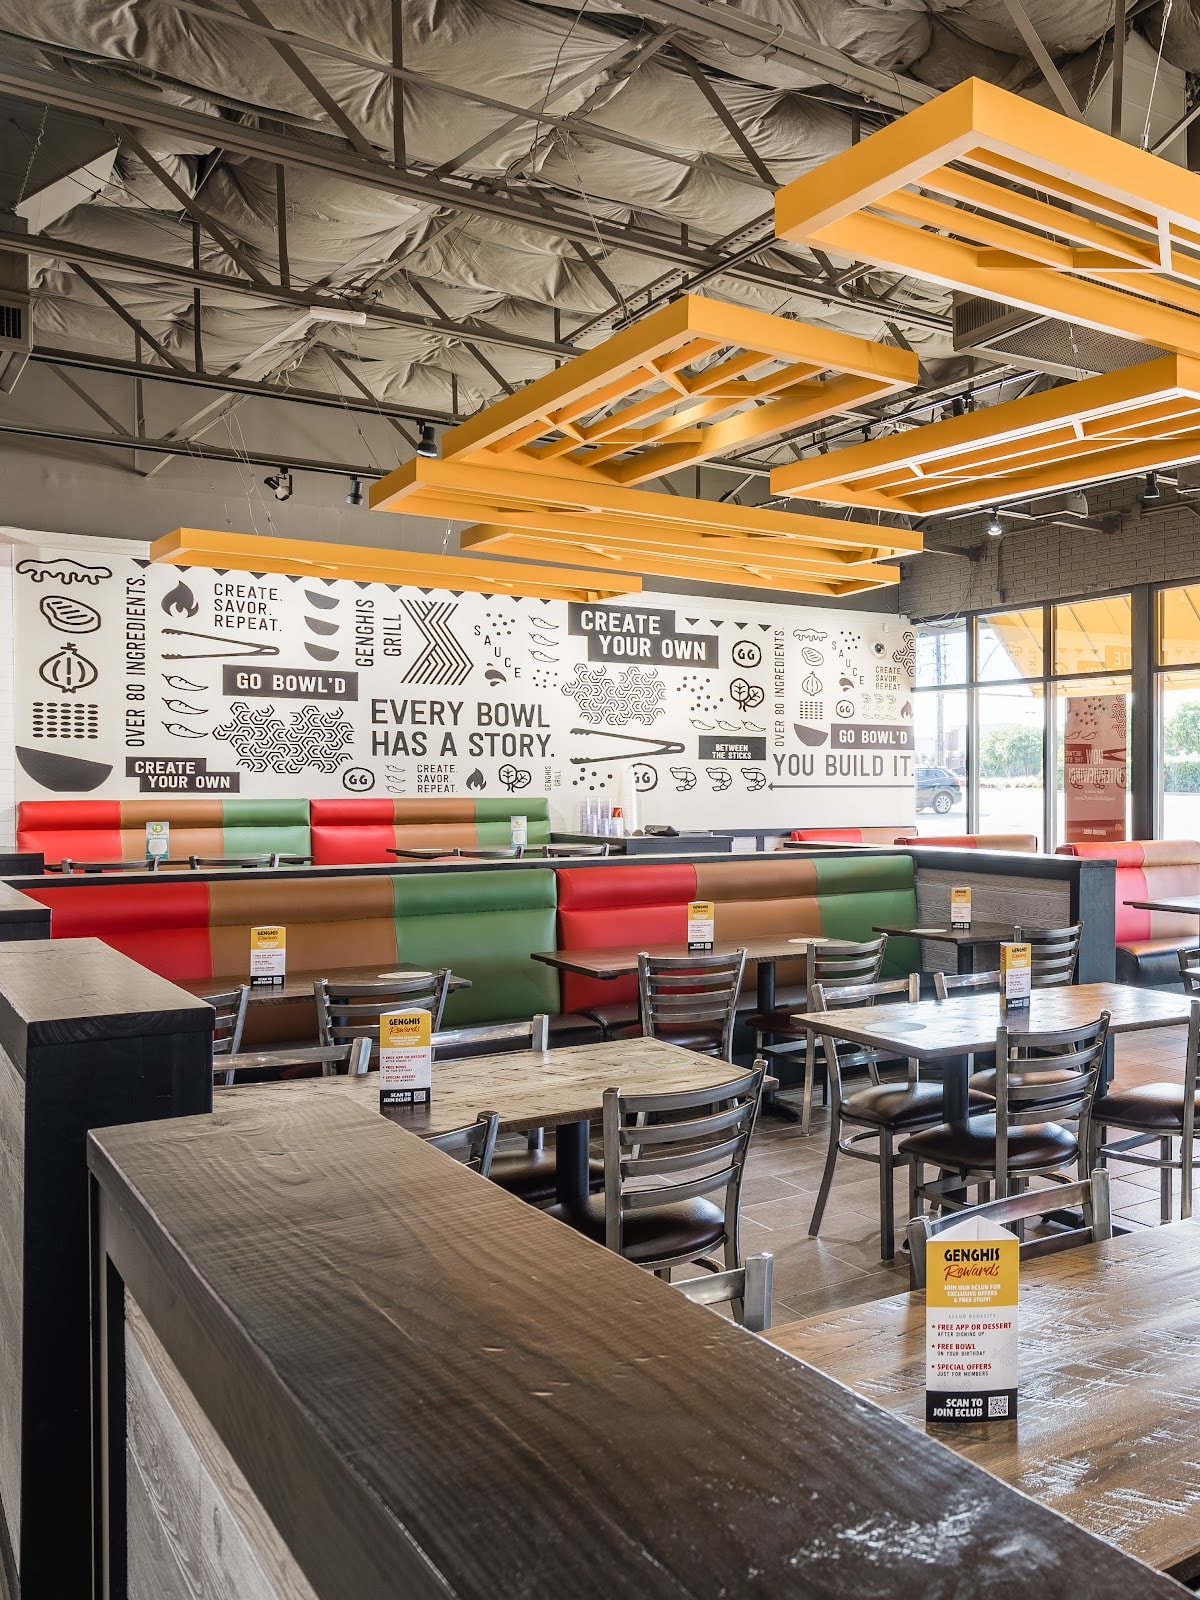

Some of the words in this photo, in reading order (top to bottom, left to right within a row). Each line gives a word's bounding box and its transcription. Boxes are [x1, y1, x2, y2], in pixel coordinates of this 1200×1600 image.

[214, 583, 283, 602] CREATE.
[214, 598, 272, 616] SAVOR.
[126, 574, 146, 675] INGREDIENTS.
[214, 615, 282, 632] REPEAT.
[580, 610, 661, 635] CREATE
[355, 599, 375, 667] GENGHIS
[384, 614, 402, 657] GRILL
[474, 625, 521, 678] SAUCE
[598, 634, 651, 657] YOUR
[661, 638, 706, 661] OWN
[737, 648, 755, 661] GG
[774, 628, 785, 698] INGREDIENTS.
[831, 641, 865, 685] SAUCE
[126, 683, 145, 700] 80
[236, 672, 261, 690] GO
[272, 673, 346, 694] BOWL'D
[371, 698, 464, 726] EVERY
[477, 701, 550, 728] BOWL
[775, 703, 785, 715] 80
[839, 705, 851, 713] GG
[126, 709, 145, 747] OVER
[775, 720, 785, 747] OVER
[839, 729, 855, 743] GO
[861, 730, 908, 744] BOWL'D
[371, 730, 428, 757] HAS
[440, 731, 458, 757] A
[468, 732, 555, 758] STORY.
[715, 743, 749, 753] BETWEEN
[712, 751, 726, 760] THE
[728, 751, 752, 760] STICKS
[135, 761, 195, 775] CREATE
[417, 764, 459, 773] CREATE.
[773, 754, 814, 777] YOU
[826, 754, 884, 777] BUILD
[893, 755, 914, 777] IT.
[148, 775, 191, 789] YOUR
[195, 775, 230, 789] OWN
[349, 775, 368, 785] GG
[417, 774, 453, 784] SAVOR.
[544, 765, 552, 791] GENGHIS
[417, 784, 459, 793] REPEAT.
[389, 1018, 420, 1026] GENGHIS
[944, 1247, 1000, 1261] GENGHIS
[944, 1263, 1000, 1280] Rewards
[982, 1322, 1012, 1330] DESSERT
[945, 1398, 970, 1408] SCAN
[971, 1398, 983, 1407] TO
[933, 1407, 953, 1417] JOIN
[955, 1407, 983, 1417] ECLUB
